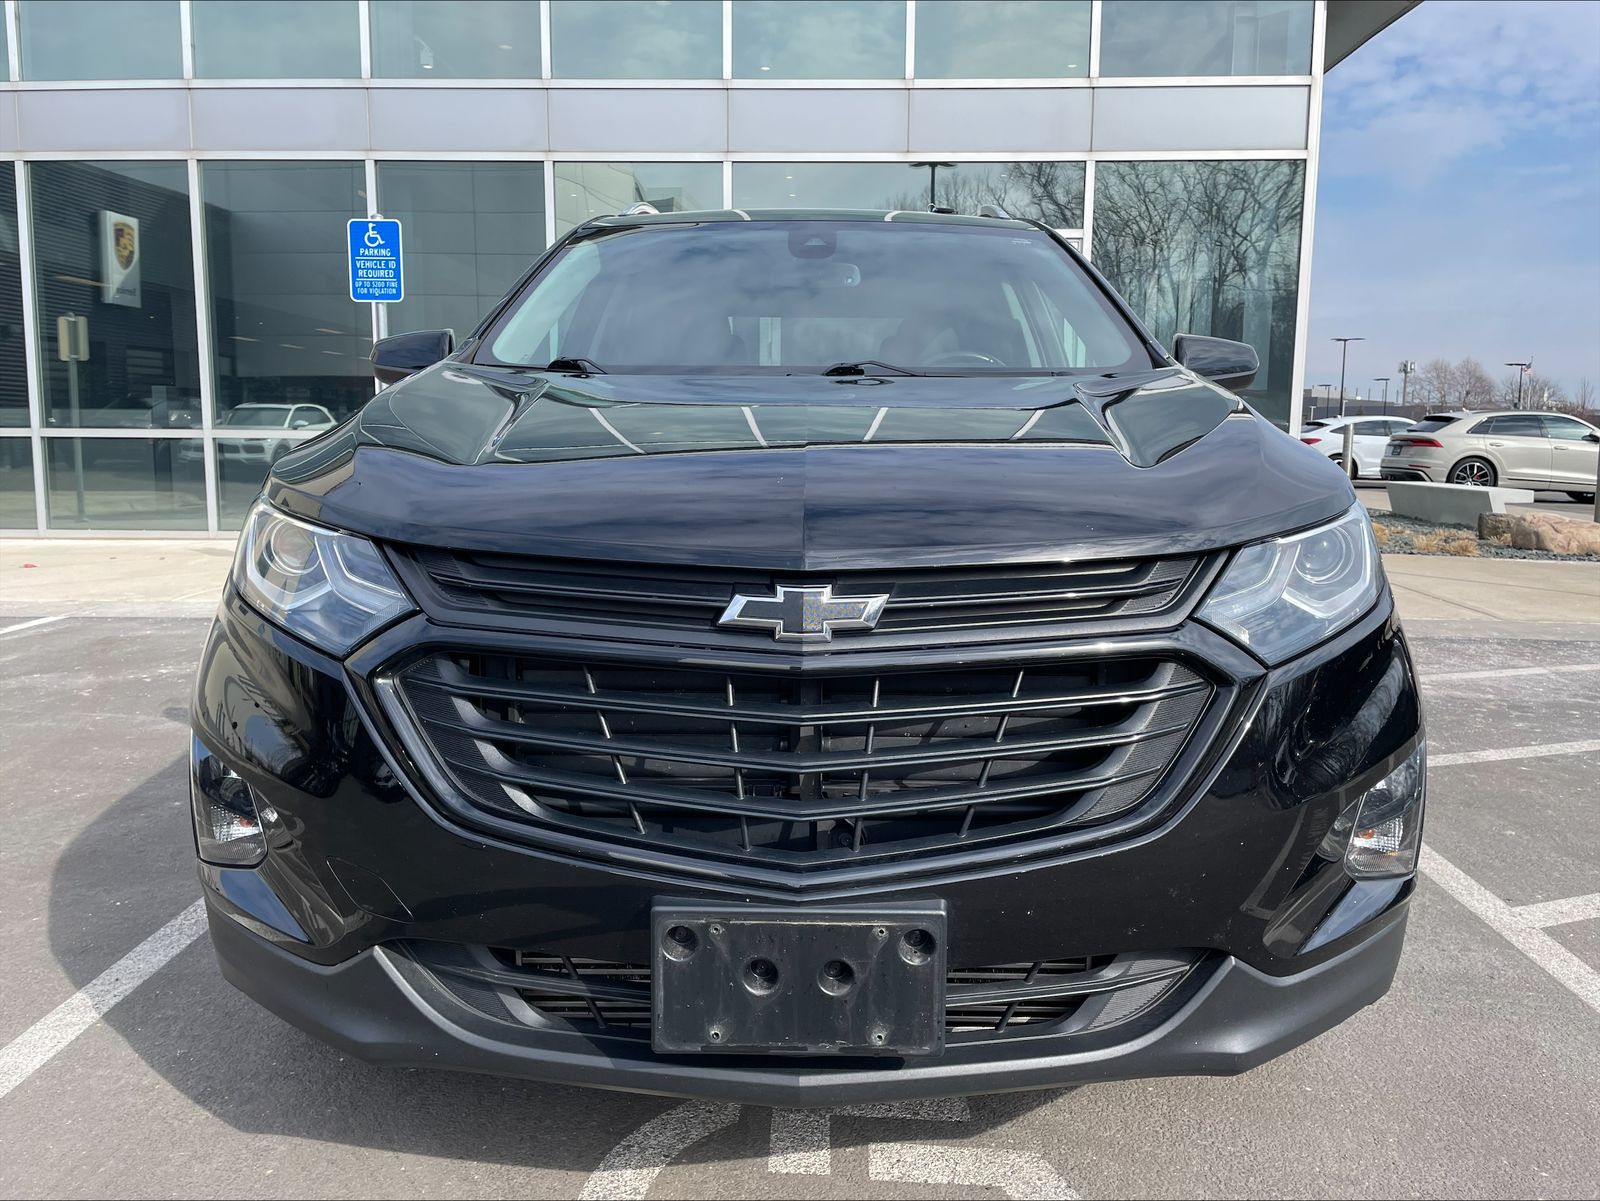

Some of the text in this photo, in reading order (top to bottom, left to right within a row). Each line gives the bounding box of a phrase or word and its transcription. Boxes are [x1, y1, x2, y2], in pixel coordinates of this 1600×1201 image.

[360, 248, 390, 256] PARKING
[356, 260, 396, 268] VEHICLE ID
[358, 270, 394, 278] REQUIRED
